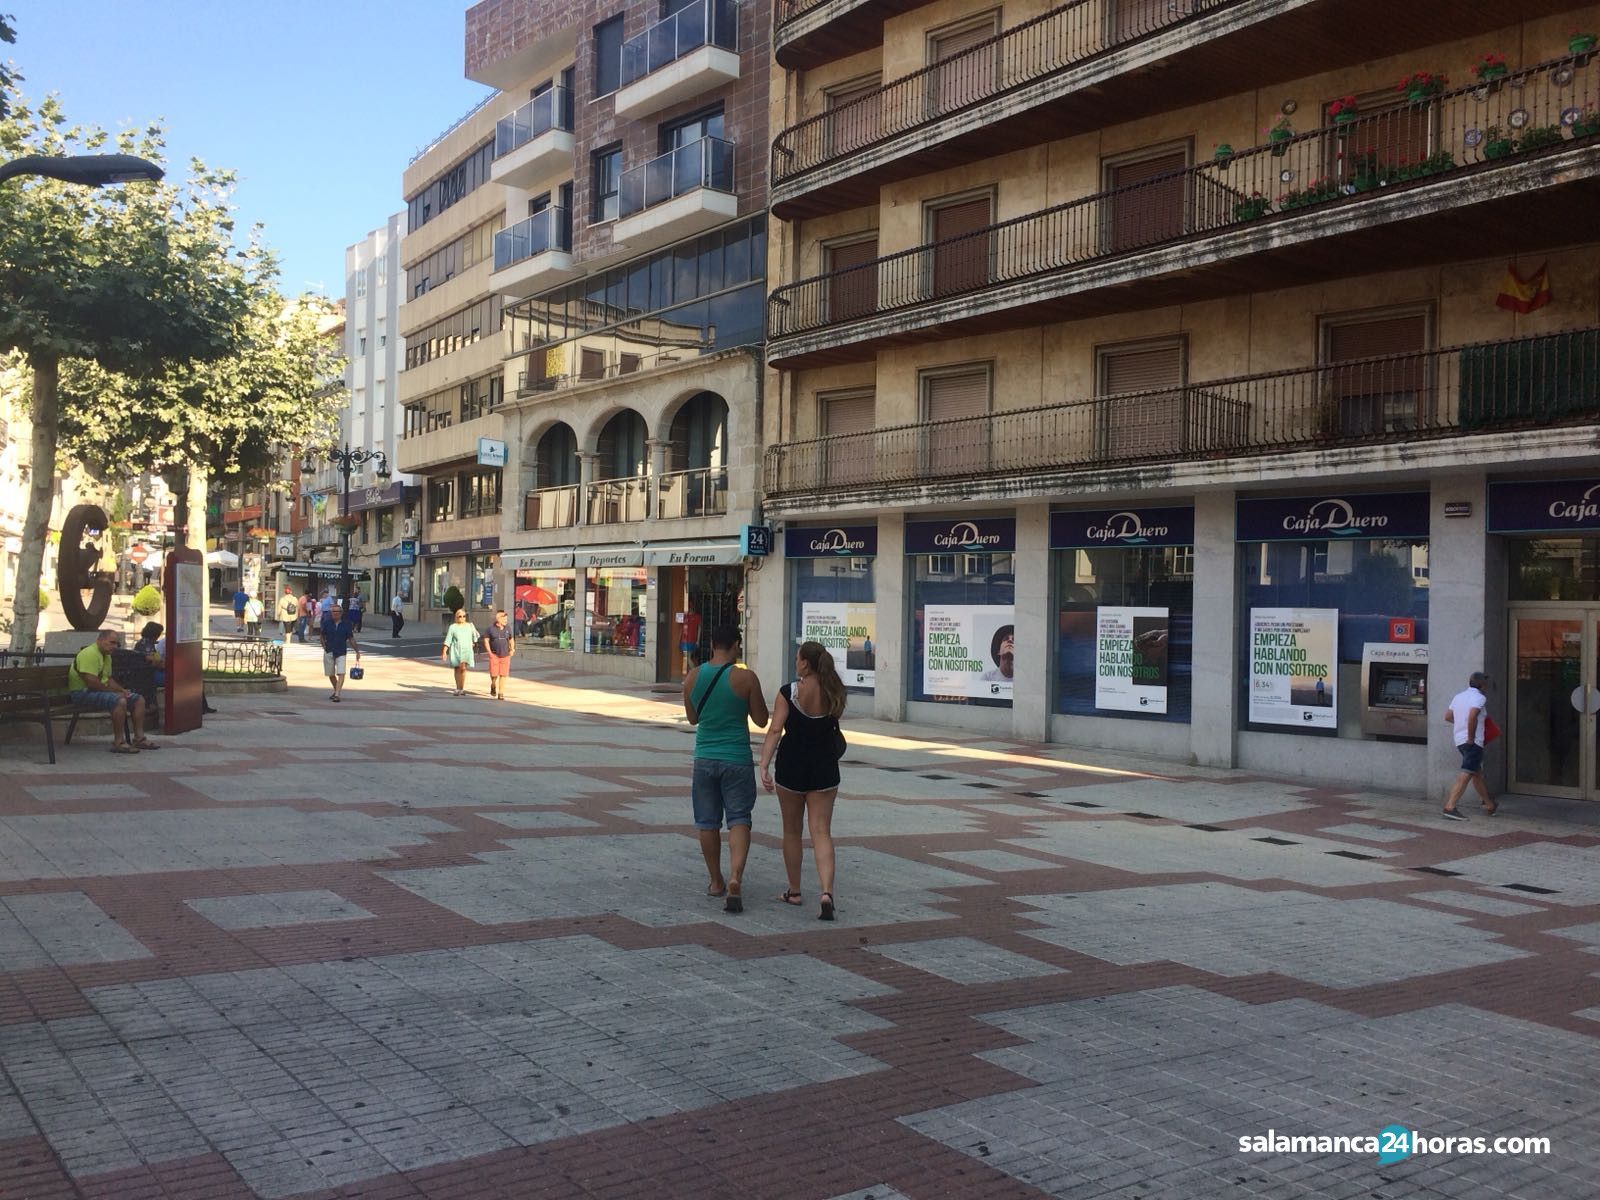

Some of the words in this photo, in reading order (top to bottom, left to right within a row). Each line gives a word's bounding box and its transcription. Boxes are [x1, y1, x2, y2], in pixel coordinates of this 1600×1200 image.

[1283, 515, 1320, 533] Caja
[1309, 499, 1388, 529] Duero
[1549, 500, 1597, 521] Caja
[1087, 526, 1115, 541] Caja
[1107, 512, 1168, 538] Duero
[750, 532, 763, 545] 24
[810, 540, 830, 552] Caja
[824, 529, 865, 549] Duero
[934, 534, 958, 548] Caja
[951, 522, 1000, 545] Duero
[530, 559, 553, 567] Forma
[589, 556, 626, 566] Deportes
[669, 553, 682, 563] En
[683, 552, 715, 563] Forma
[806, 625, 832, 637] EMPIEZA
[833, 626, 867, 637] HABLANDO
[820, 637, 851, 648] NOSOTROS
[928, 633, 960, 645] EMPIEZA
[1099, 639, 1134, 652] EMPIEZA
[1254, 633, 1297, 647] EMPIEZA
[928, 646, 968, 658] HABLANDO
[1254, 647, 1307, 662] HABLANDO
[1385, 651, 1410, 659] España
[928, 659, 943, 671] CON
[944, 660, 983, 672] NOSOTROS
[1099, 653, 1143, 665] HABLANDO
[1099, 665, 1116, 677] CON
[1117, 666, 1160, 679] NOSOTROS
[1253, 661, 1273, 675] CON
[1275, 663, 1328, 677] NOSOTROS
